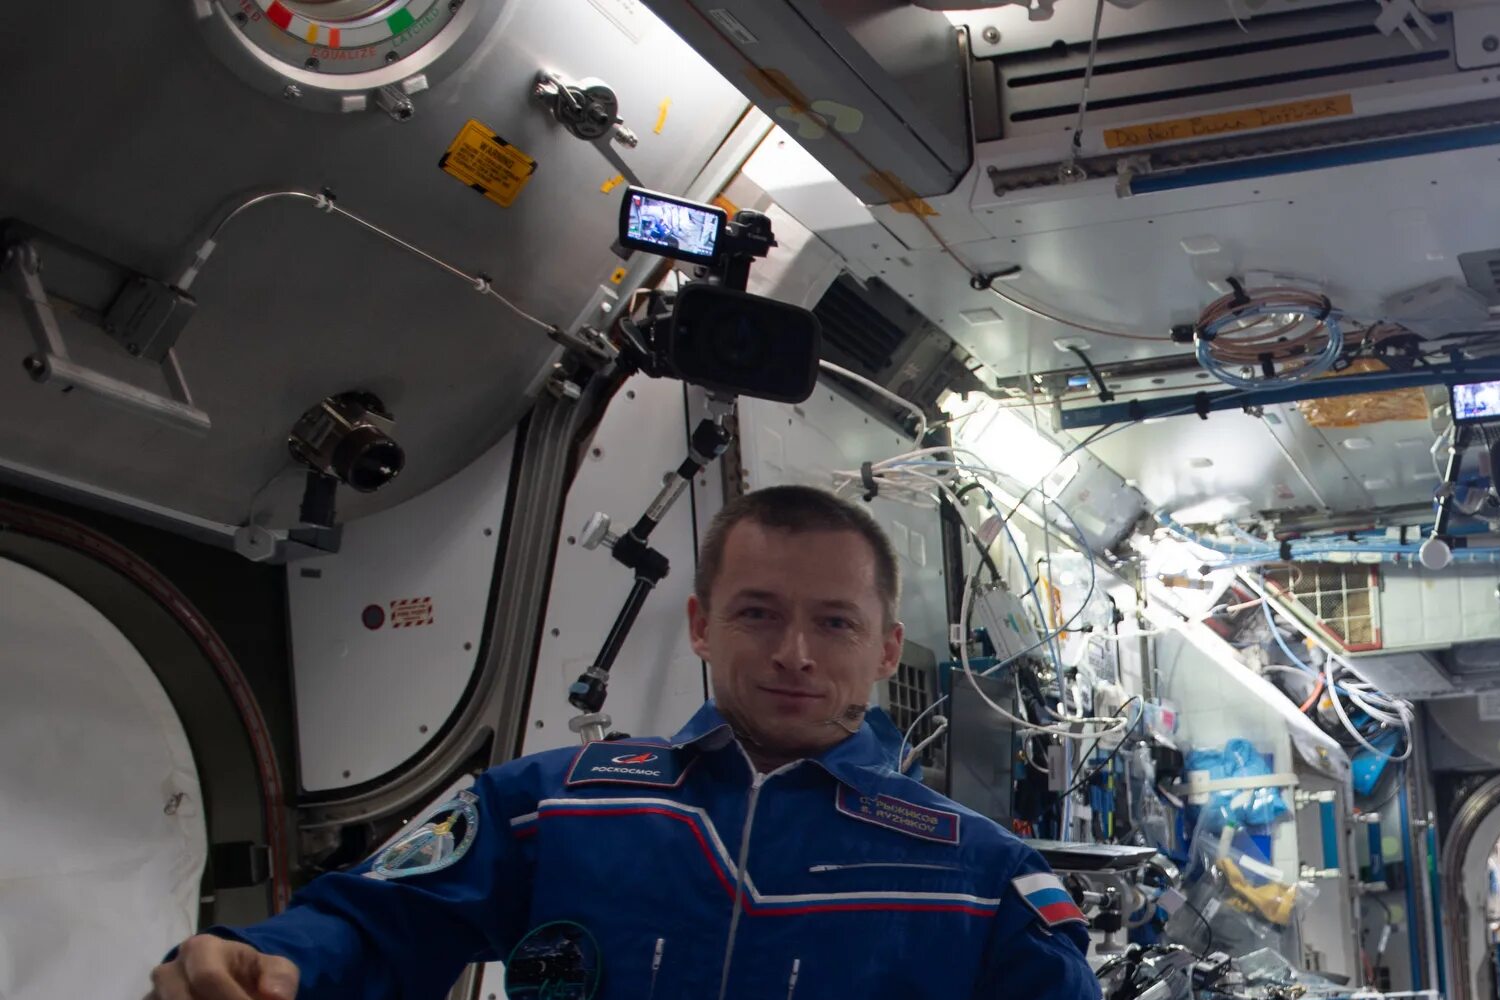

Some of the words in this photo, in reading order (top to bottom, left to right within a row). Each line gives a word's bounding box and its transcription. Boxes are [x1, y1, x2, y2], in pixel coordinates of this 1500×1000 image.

[391, 7, 440, 47] LATCHED
[311, 47, 378, 61] EQUALIZE
[591, 766, 661, 777] РОСКОСМОС
[876, 810, 936, 833] RYZHIKOV
